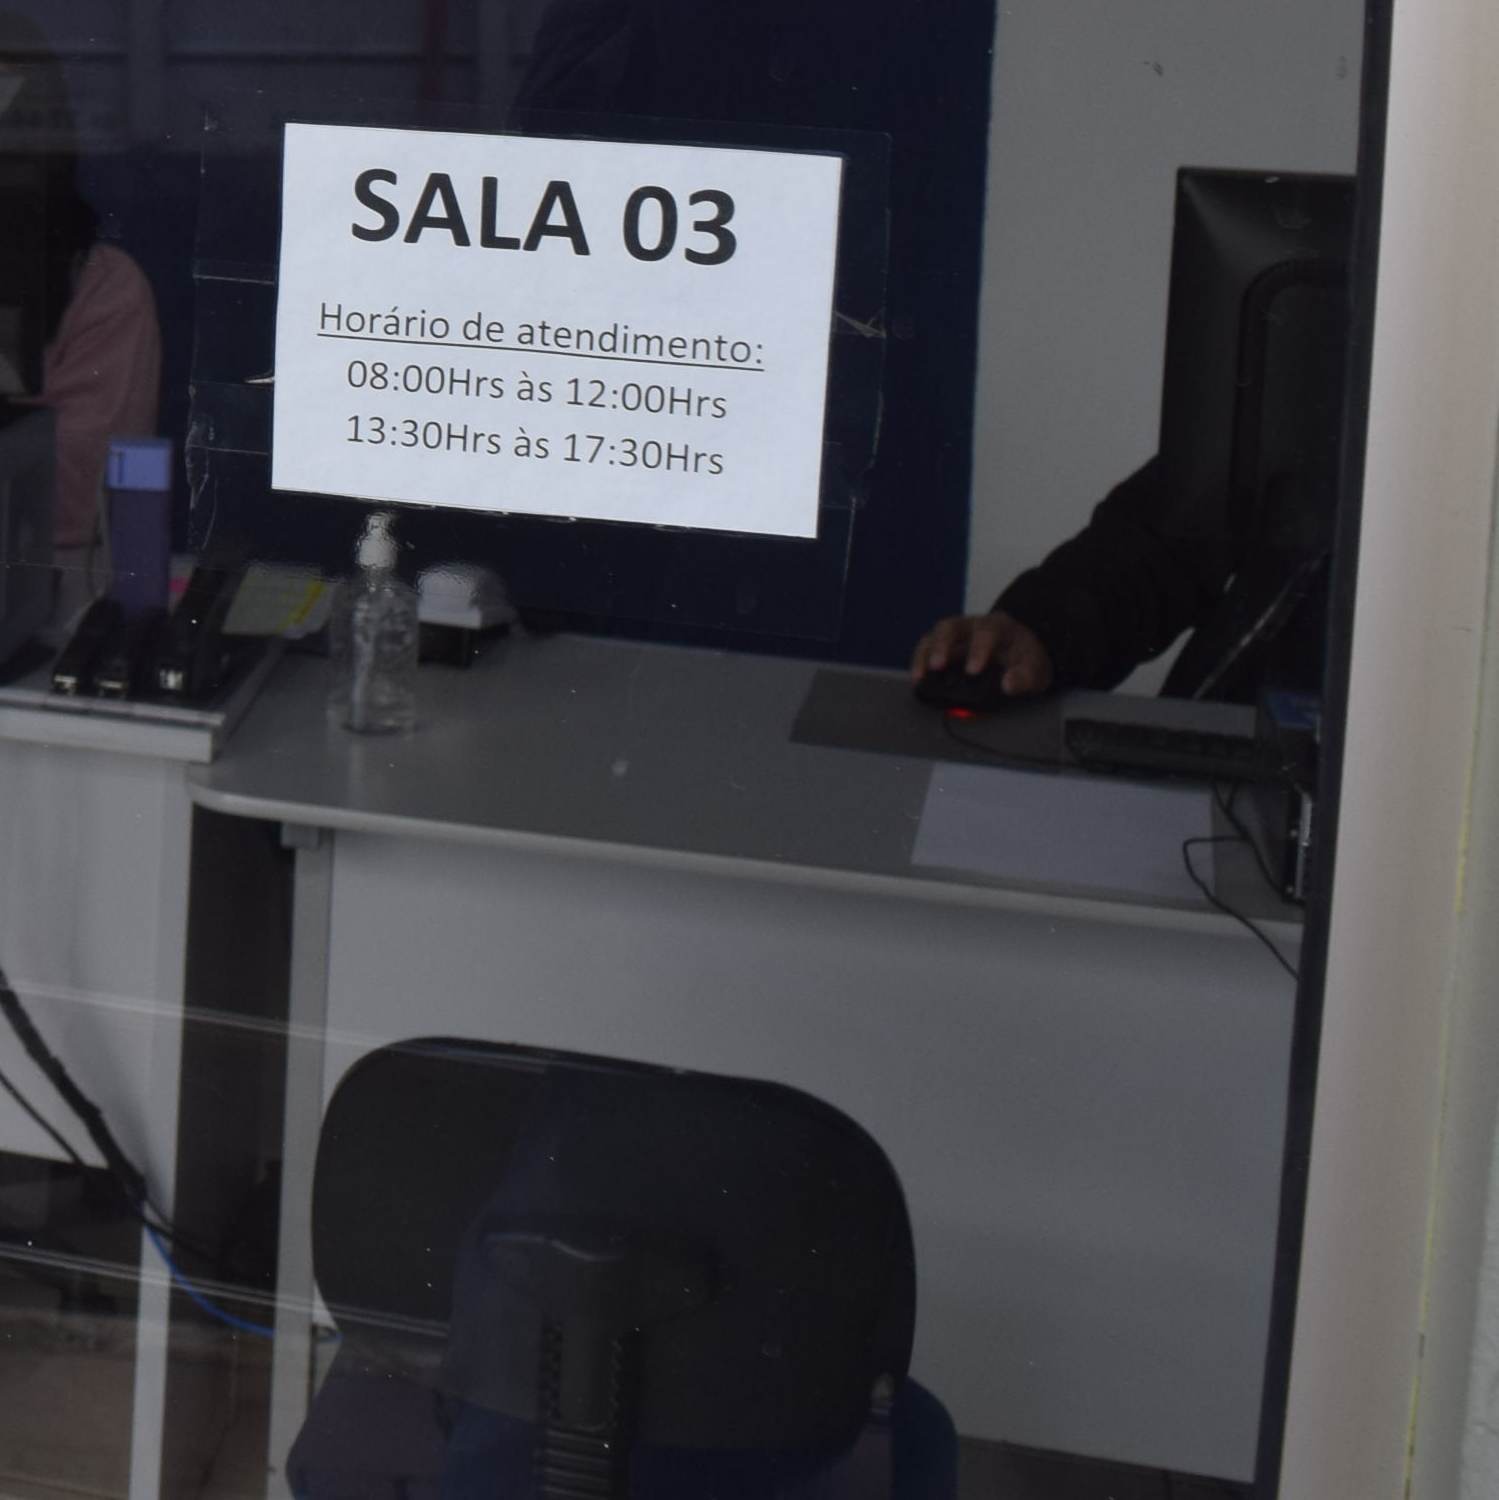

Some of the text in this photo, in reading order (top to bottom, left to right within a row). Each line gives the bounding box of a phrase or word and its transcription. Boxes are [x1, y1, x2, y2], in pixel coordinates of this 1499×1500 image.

[350, 167, 738, 266] SALA 03
[319, 302, 765, 366] Horário de atendimento:
[346, 360, 728, 419] 08:00Hrs às 12:00Hrs
[346, 415, 725, 476] 13:30Hrs às 17:30Hrs
